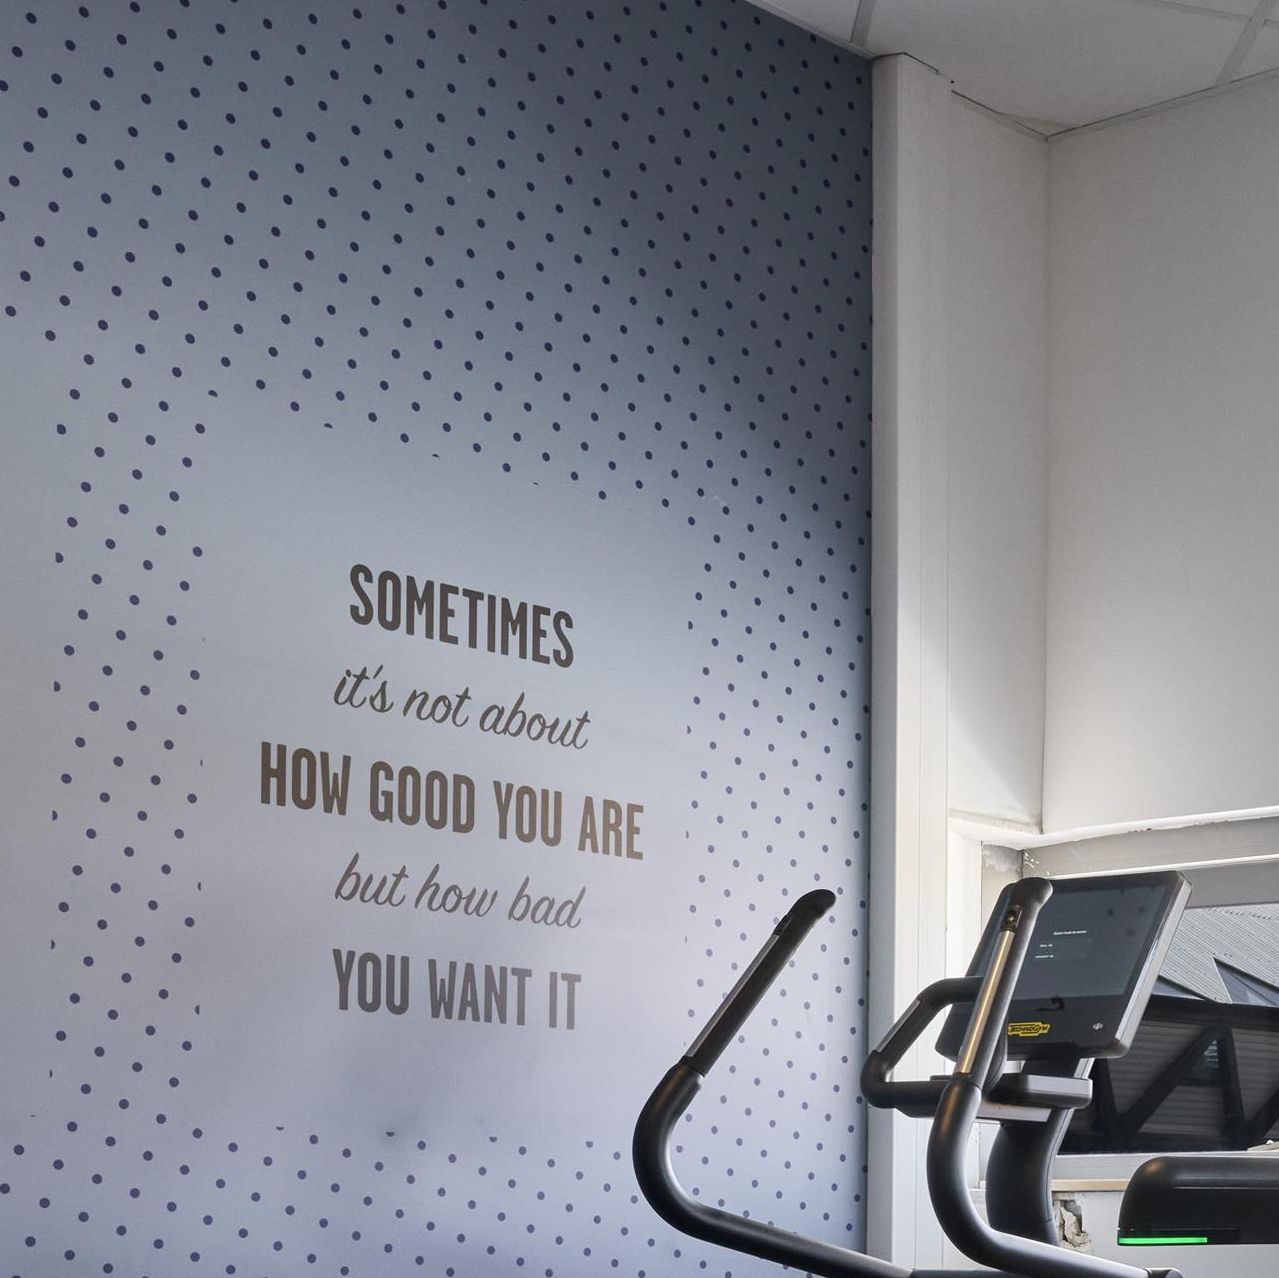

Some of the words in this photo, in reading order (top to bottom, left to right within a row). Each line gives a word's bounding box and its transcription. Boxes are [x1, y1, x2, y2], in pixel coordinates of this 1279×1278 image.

[349, 563, 574, 668] SOMETIMES
[333, 664, 394, 713] it's
[403, 686, 472, 727] not
[479, 691, 590, 749] about
[260, 741, 352, 815] HOW
[369, 760, 475, 834] GOOD
[493, 780, 563, 847] YOU
[578, 795, 644, 860] ARE
[335, 852, 408, 907] but
[414, 863, 498, 917] how
[508, 876, 586, 929] bad
[332, 948, 410, 1015] YOU
[428, 958, 533, 1026] WANT
[548, 971, 582, 1031] IT
